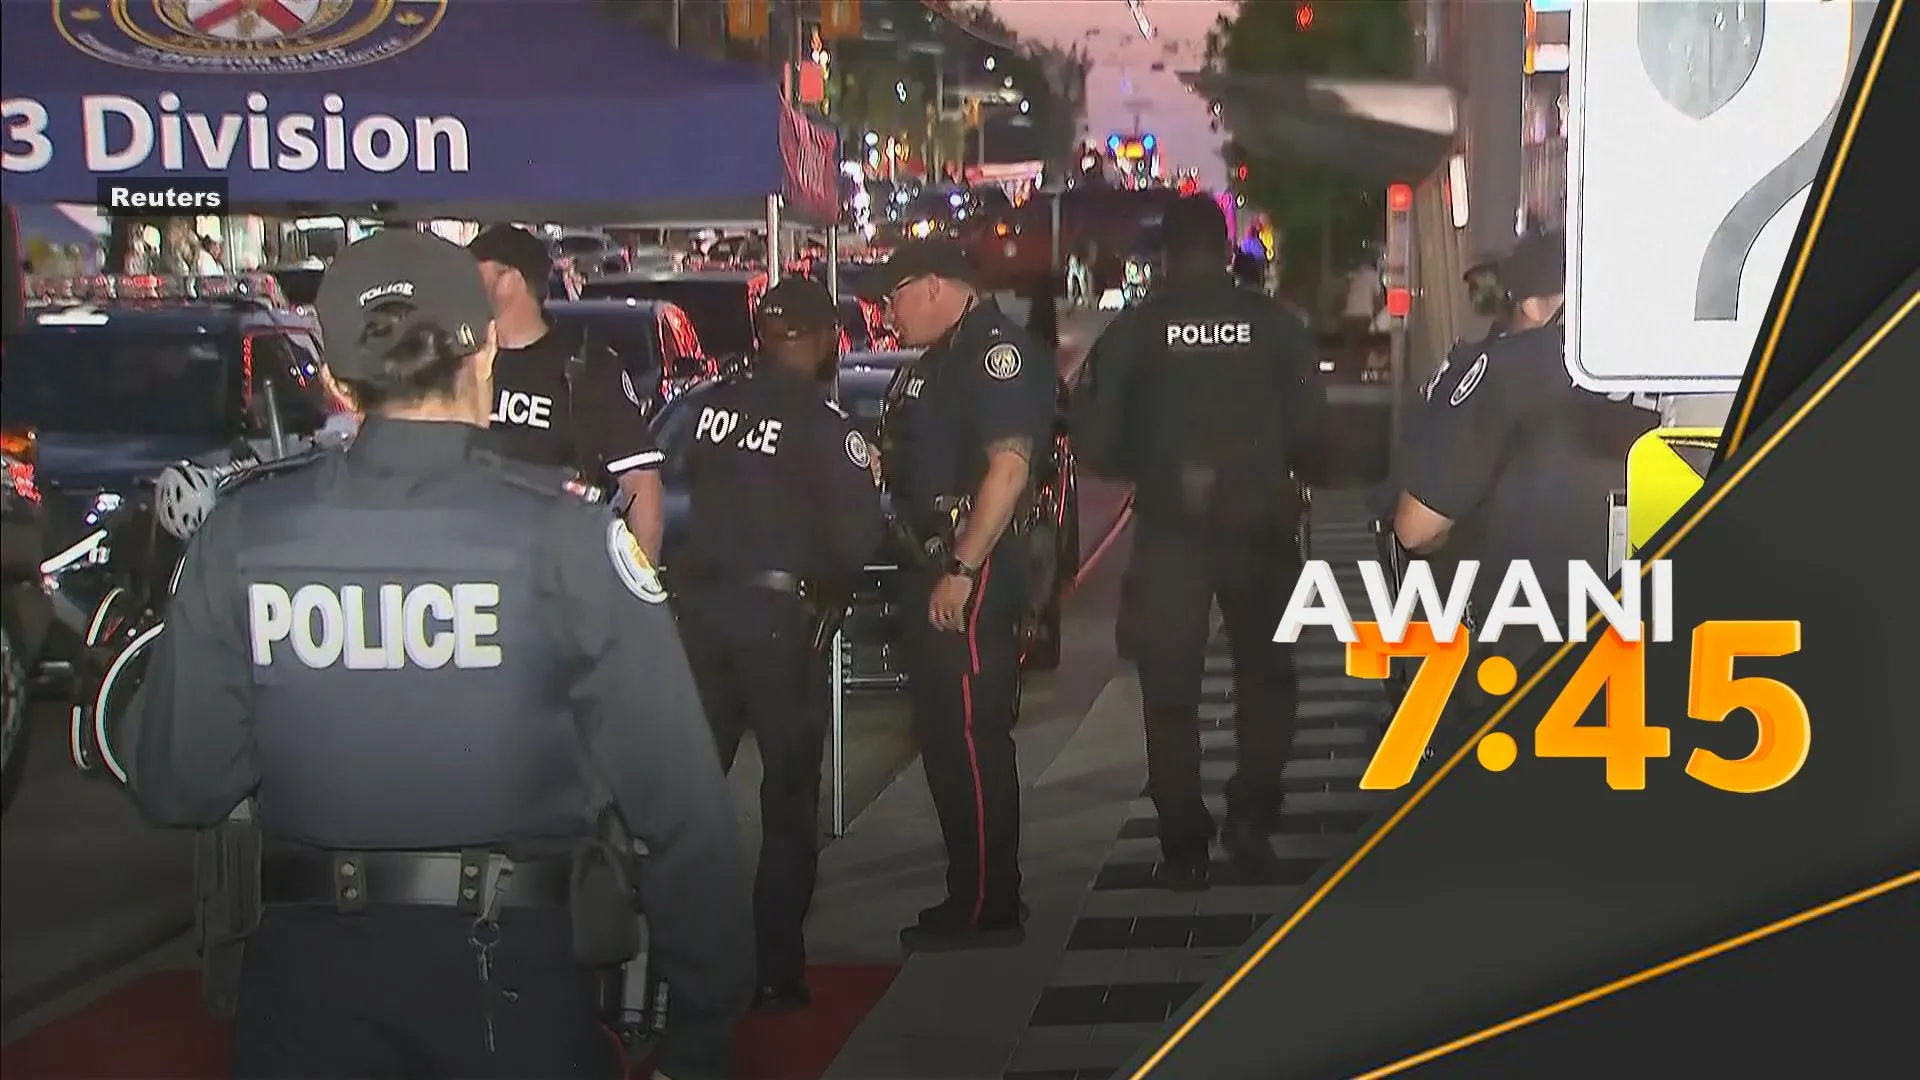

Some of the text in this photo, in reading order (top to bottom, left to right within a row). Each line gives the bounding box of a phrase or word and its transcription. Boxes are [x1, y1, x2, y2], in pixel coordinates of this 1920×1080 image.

[0, 91, 470, 172] 3 Division
[1167, 323, 1252, 345] POLICE
[248, 583, 502, 670] POLICE
